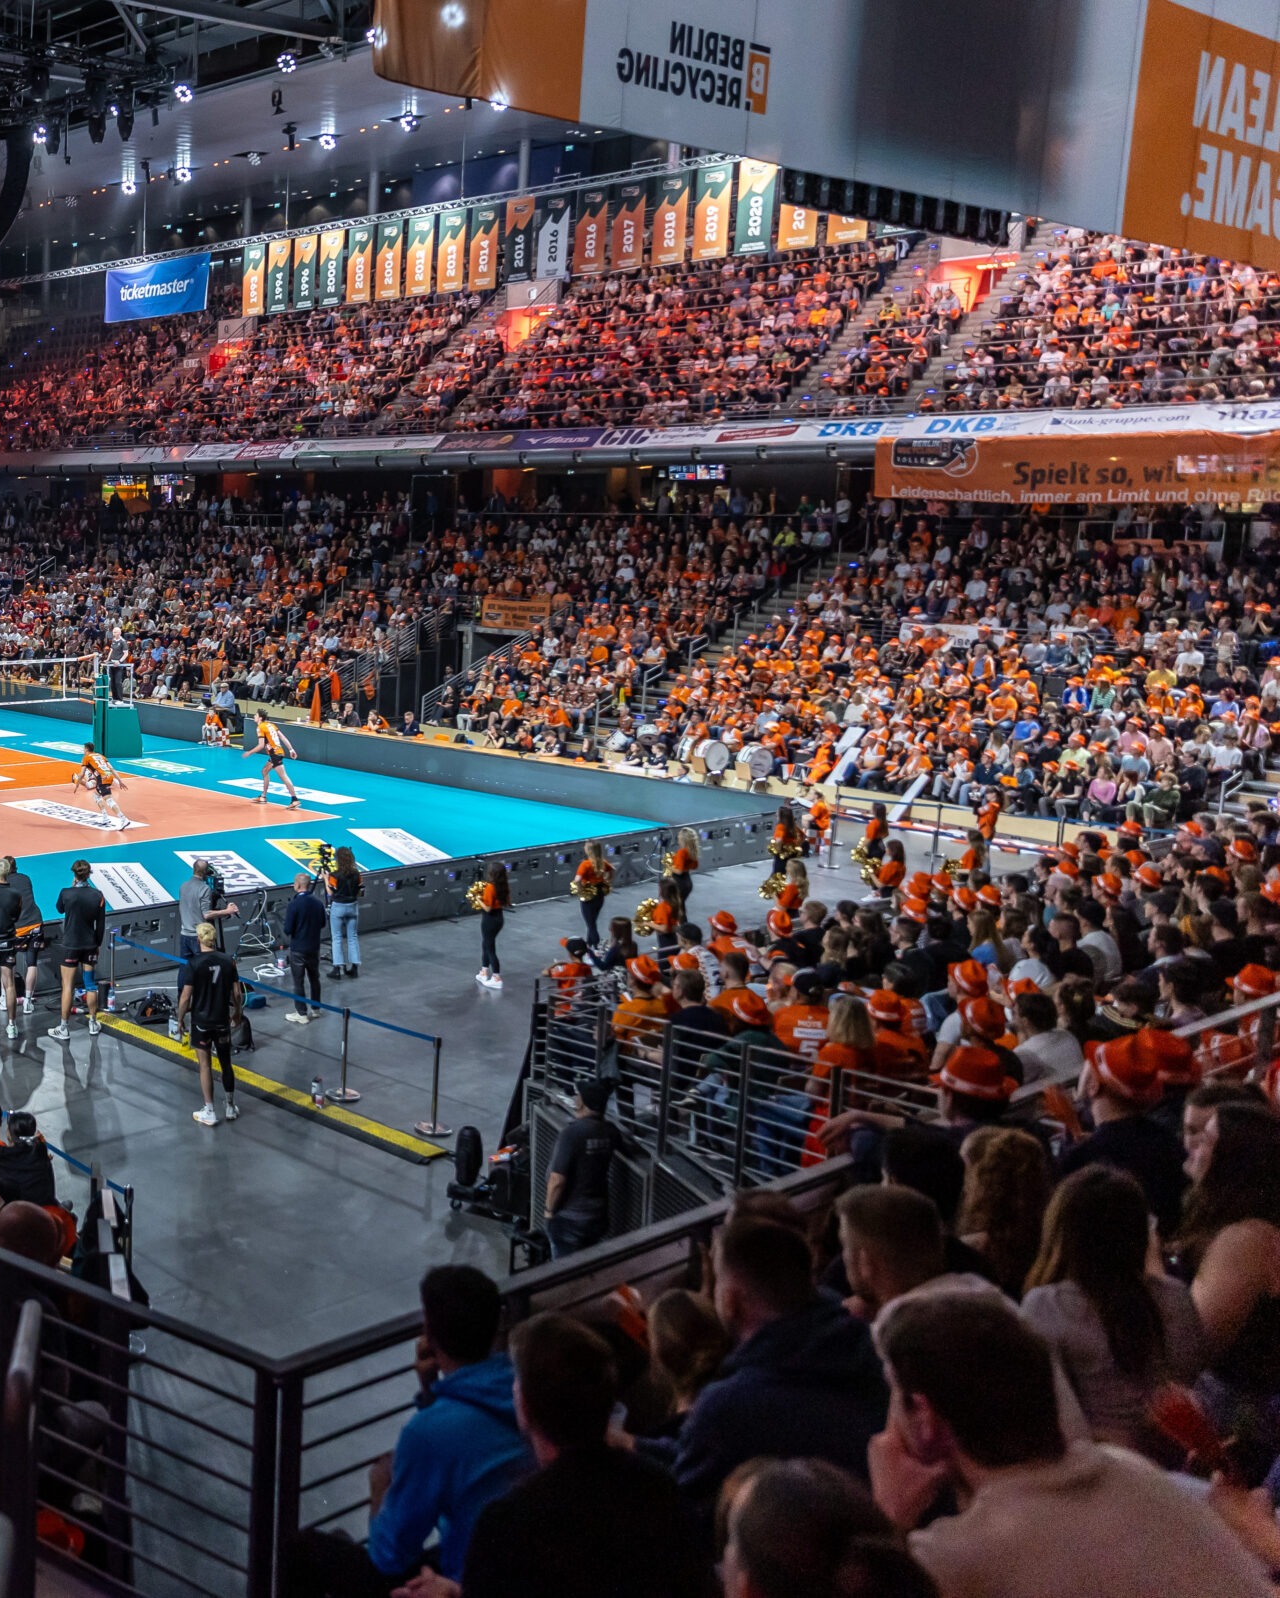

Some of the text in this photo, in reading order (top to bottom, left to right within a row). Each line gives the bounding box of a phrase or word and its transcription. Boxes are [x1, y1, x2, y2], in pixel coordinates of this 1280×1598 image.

[663, 211, 677, 248] 2018
[704, 205, 719, 243] 2019
[747, 195, 765, 238] 2020
[792, 207, 806, 231] 20
[513, 233, 525, 269] 2016
[547, 229, 560, 264] 2016
[584, 223, 598, 259] 2016
[622, 219, 635, 254] 2017
[383, 251, 395, 286] 2004
[478, 239, 491, 274] 2014
[120, 278, 189, 302] ticketmaster
[274, 271, 284, 301] 1994
[300, 267, 310, 297] 1996
[326, 260, 337, 294] 2000
[818, 422, 884, 437] DKB
[924, 417, 997, 434] DKB
[1062, 414, 1190, 427] funk-gruppe.com
[1013, 460, 1088, 490] Spielt
[1096, 466, 1133, 487] so,
[891, 485, 1014, 504] Leidenschaftlich,
[1021, 489, 1072, 503] immer
[1075, 492, 1102, 502] am
[1106, 488, 1150, 502] Limit
[1154, 487, 1190, 502] und
[1194, 488, 1240, 502] ohne
[208, 964, 221, 984] 7
[800, 1041, 819, 1060] 5
